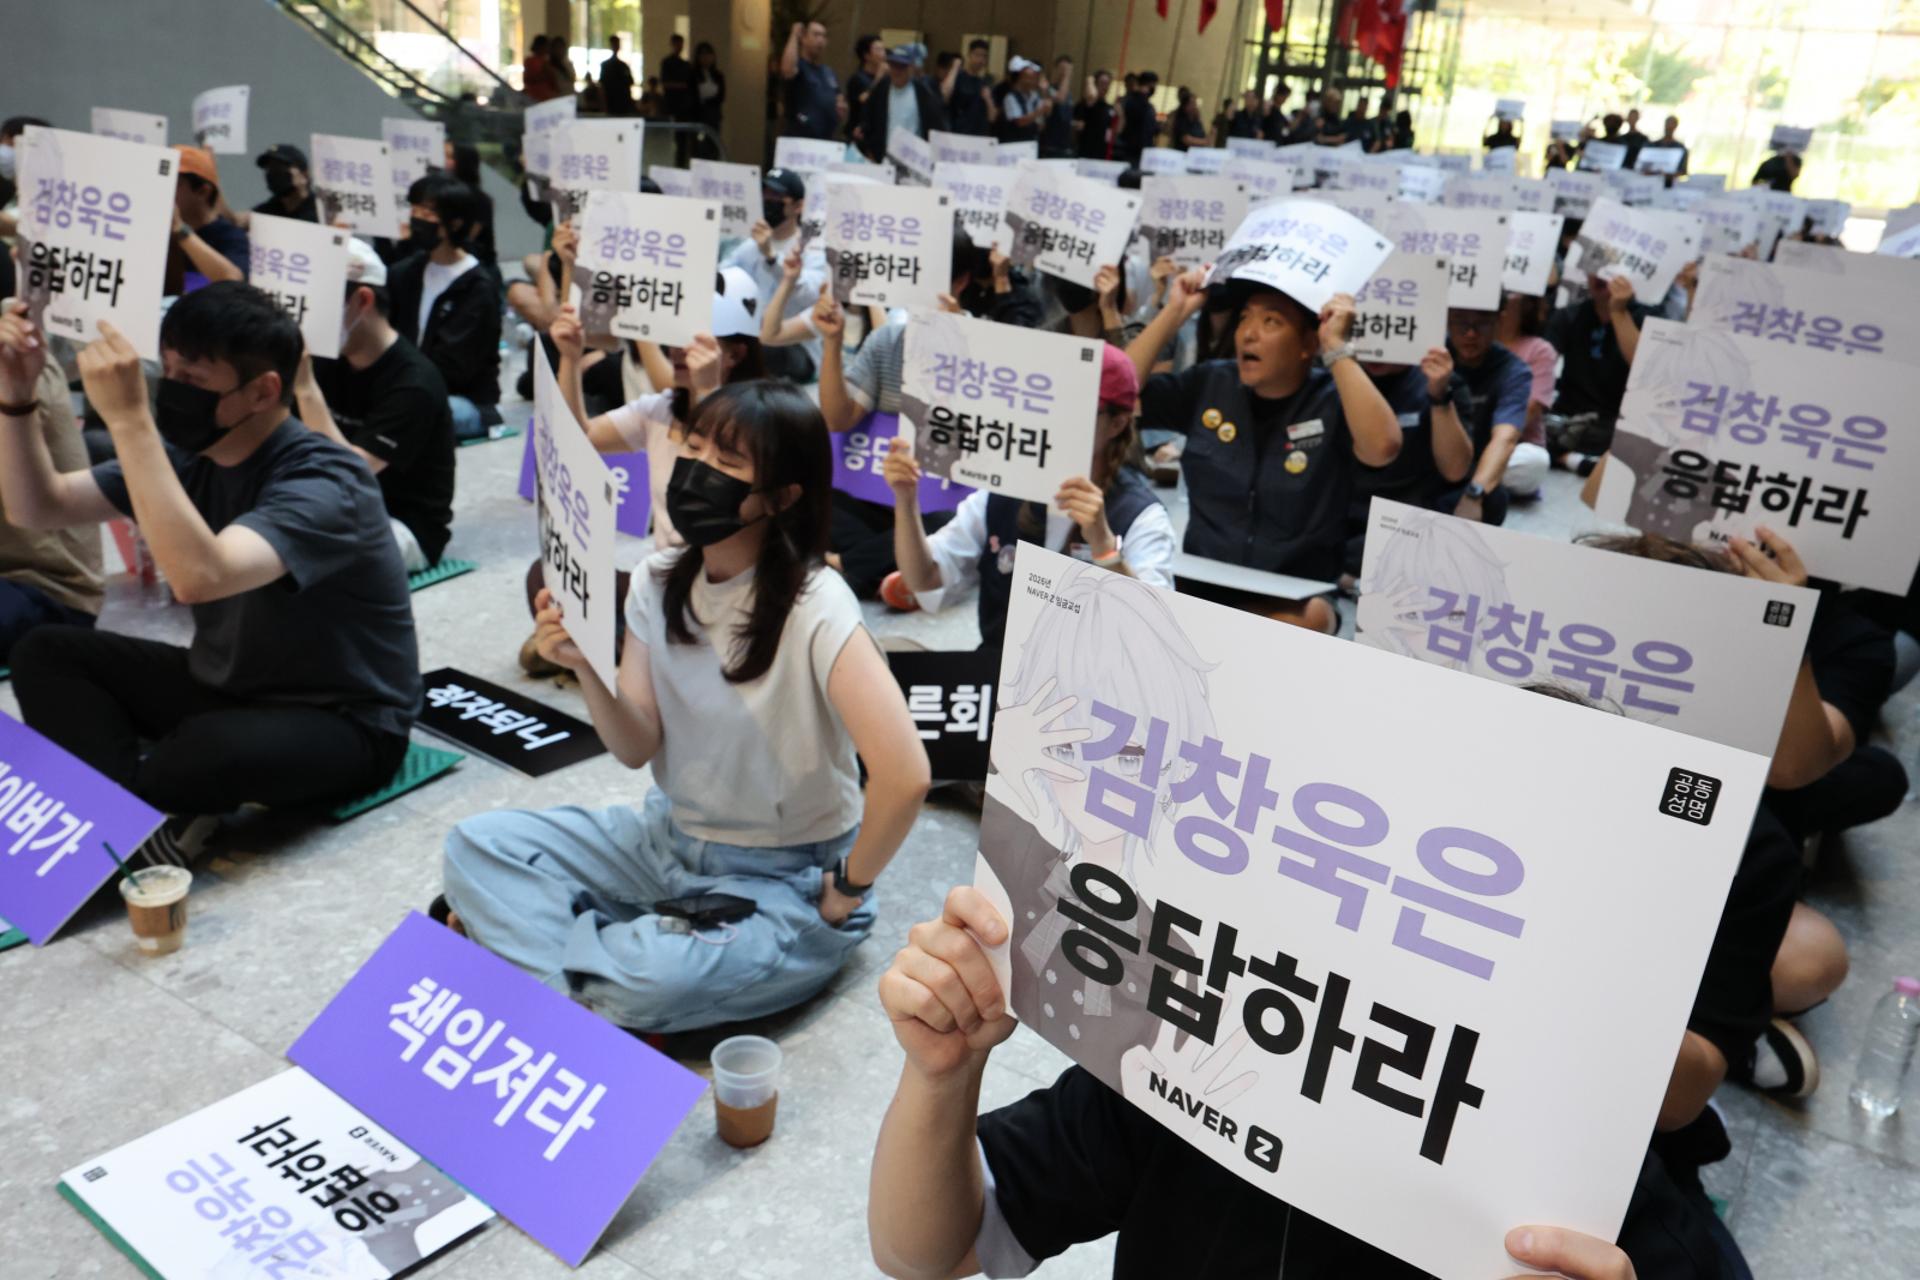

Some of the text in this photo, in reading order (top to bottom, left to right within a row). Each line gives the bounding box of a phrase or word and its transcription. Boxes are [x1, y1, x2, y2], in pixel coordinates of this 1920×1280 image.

[34, 178, 132, 241] 김창욱은
[600, 226, 686, 269] 김창욱은
[837, 212, 922, 247] 김창욱은
[28, 242, 125, 308] 응답하라
[592, 271, 684, 316] 응답하라
[837, 250, 922, 285] 응답하라
[931, 352, 1055, 415] 김창욱은
[928, 405, 1052, 468] 응답하라
[1680, 381, 1888, 471] 김창욱은
[1662, 448, 1869, 540] 응답하라
[1422, 586, 1696, 716] 김창욱은
[1081, 700, 1527, 982] 김창욱은
[1056, 862, 1486, 1167] 응답하라
[388, 976, 608, 1162] 책임져라
[1148, 1071, 1279, 1167] NAVER Z
[237, 1116, 400, 1232] 응답하라
